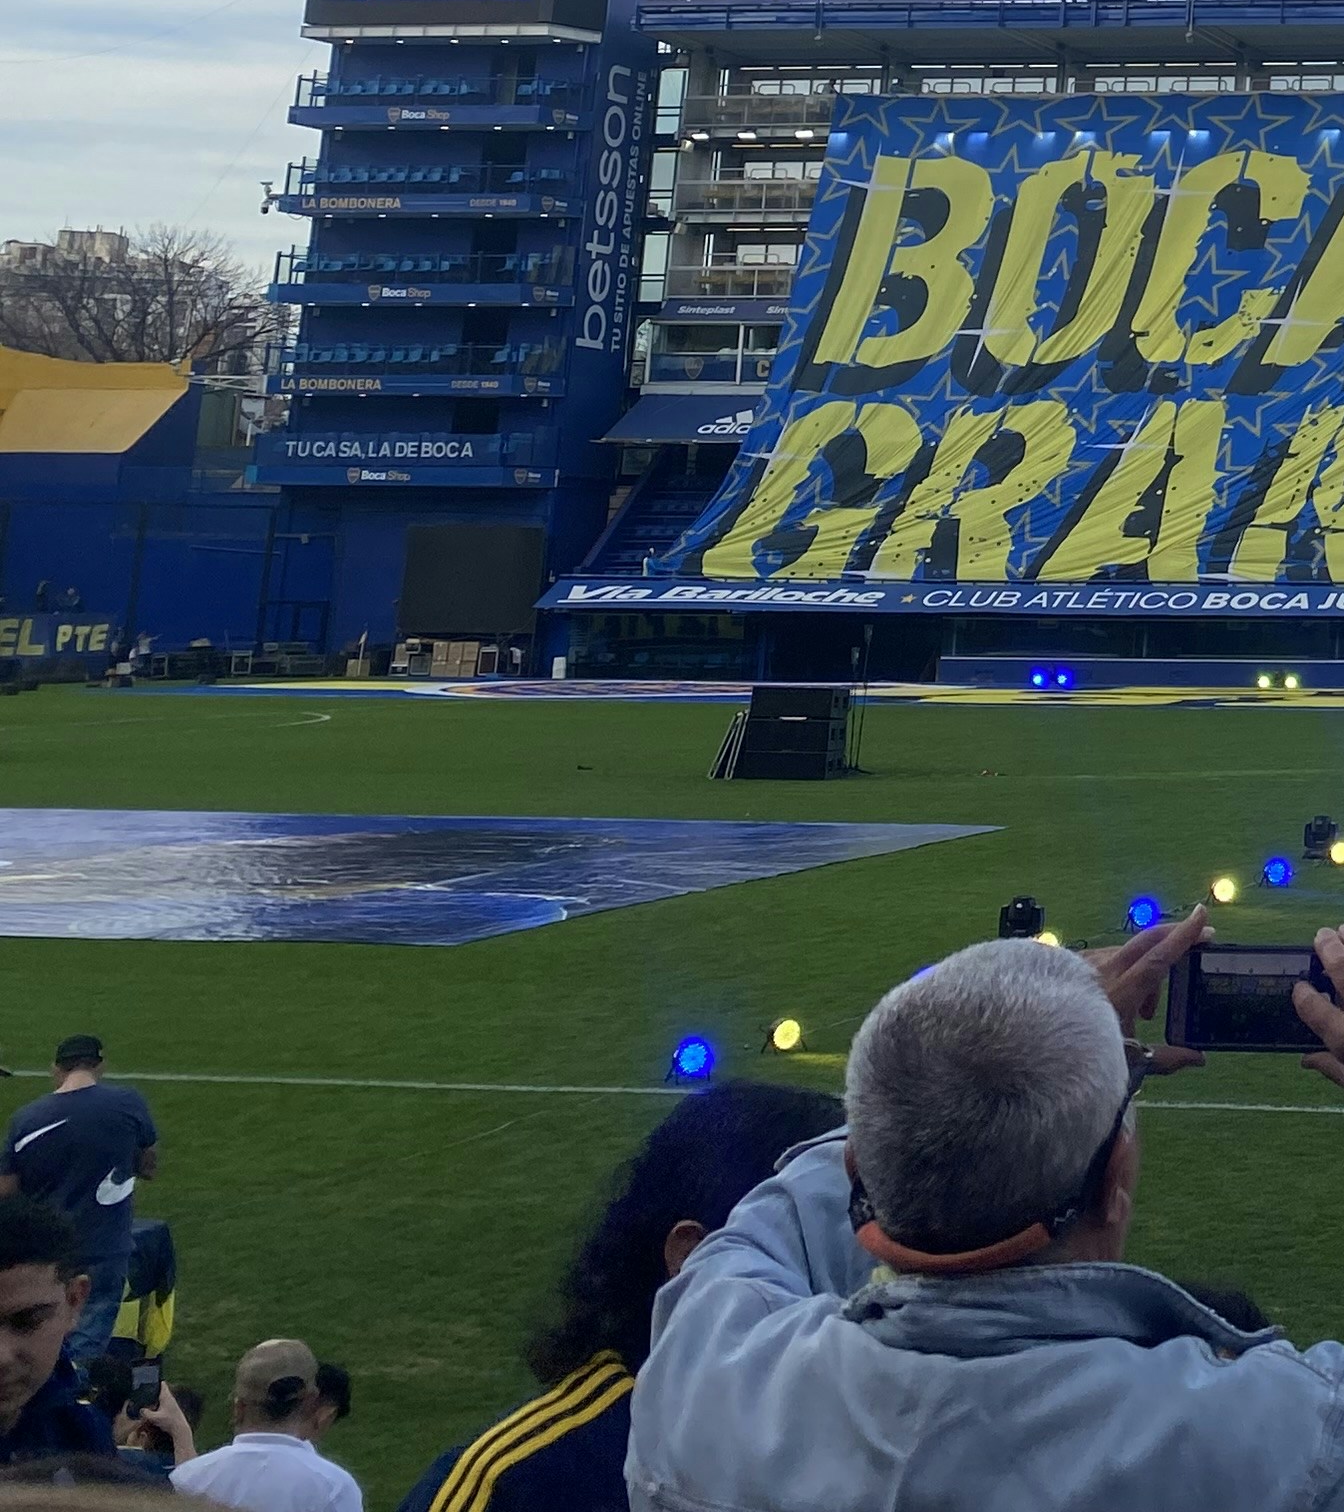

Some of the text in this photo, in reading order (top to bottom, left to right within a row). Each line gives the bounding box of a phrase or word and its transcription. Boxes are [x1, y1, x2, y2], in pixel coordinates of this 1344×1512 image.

[401, 110, 426, 120] Boca
[623, 148, 640, 240] APUESTAS
[632, 71, 647, 141] ONLINE
[302, 197, 402, 210] LA BOMBONERA
[575, 64, 631, 350] betsson
[381, 288, 407, 298] Boca
[677, 306, 736, 316] Sinteplast
[280, 378, 382, 390] LA BOMBONERA
[361, 470, 386, 481] Boca
[659, 586, 886, 603] Bariloche
[922, 590, 1021, 607] CLUB
[1024, 588, 1198, 609] ATLÉTICO
[1201, 592, 1309, 610] BOCA
[56, 624, 109, 652] PTE
